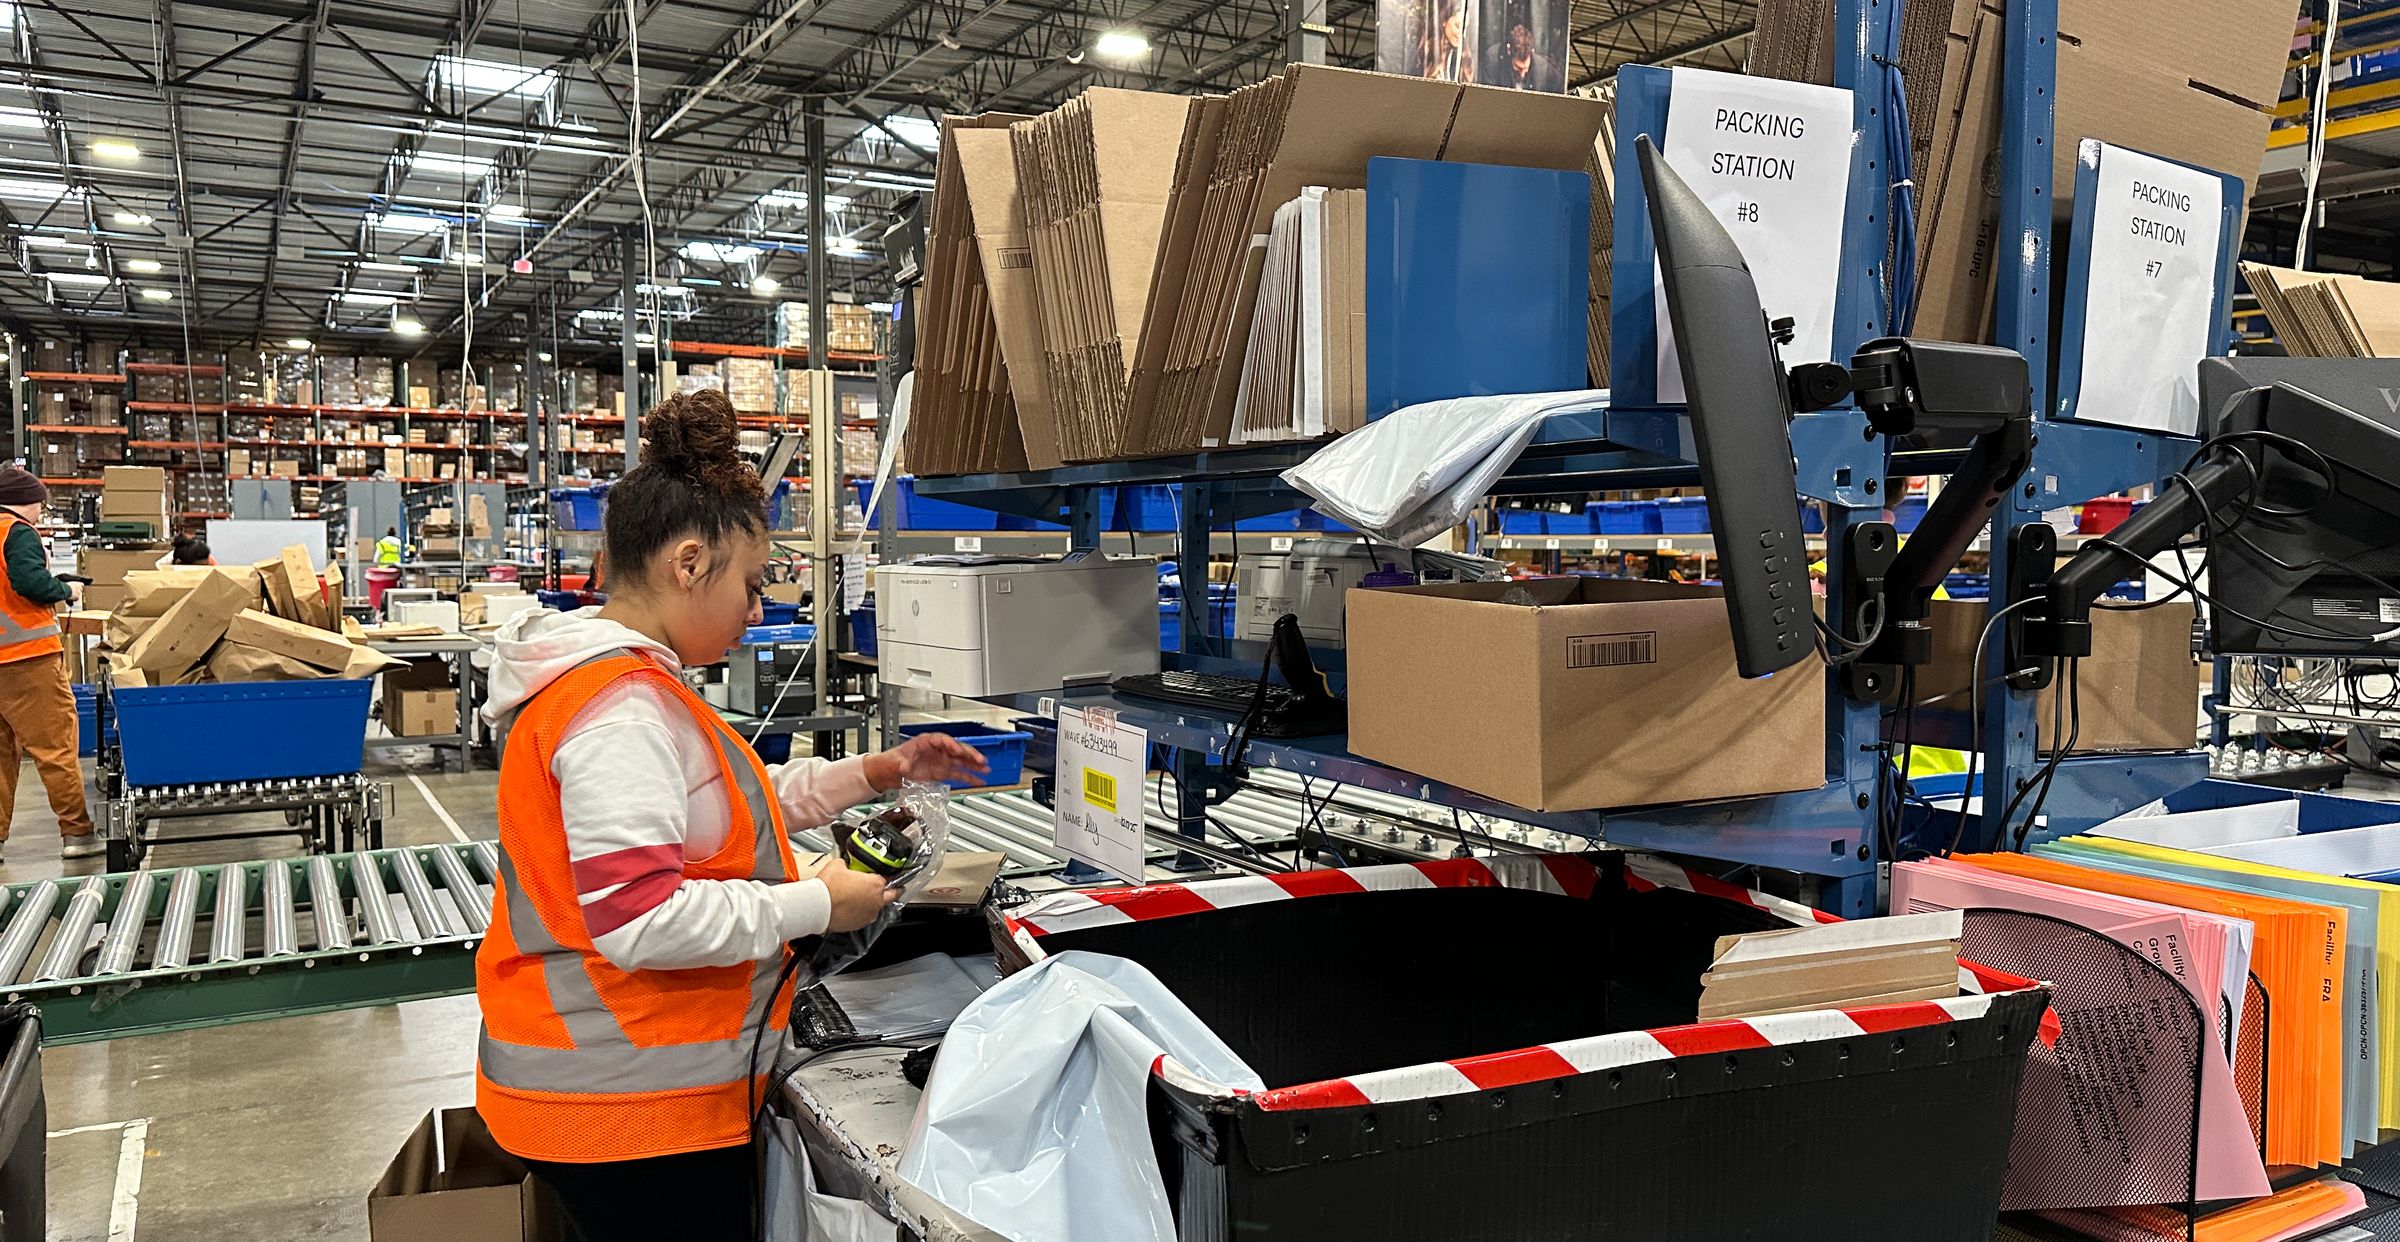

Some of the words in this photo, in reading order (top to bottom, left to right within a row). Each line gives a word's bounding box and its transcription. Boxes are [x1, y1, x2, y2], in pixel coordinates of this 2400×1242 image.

[1715, 108, 1804, 138] PACKING
[1711, 152, 1795, 180] STATION
[2132, 181, 2191, 212] PACKING
[1737, 202, 1759, 223] #8
[2131, 217, 2186, 246] STATION
[1969, 220, 1990, 279] J-16-UPC
[2146, 260, 2163, 278] #7
[1063, 728, 1081, 744] WAVE
[2166, 934, 2186, 981] Facility:
